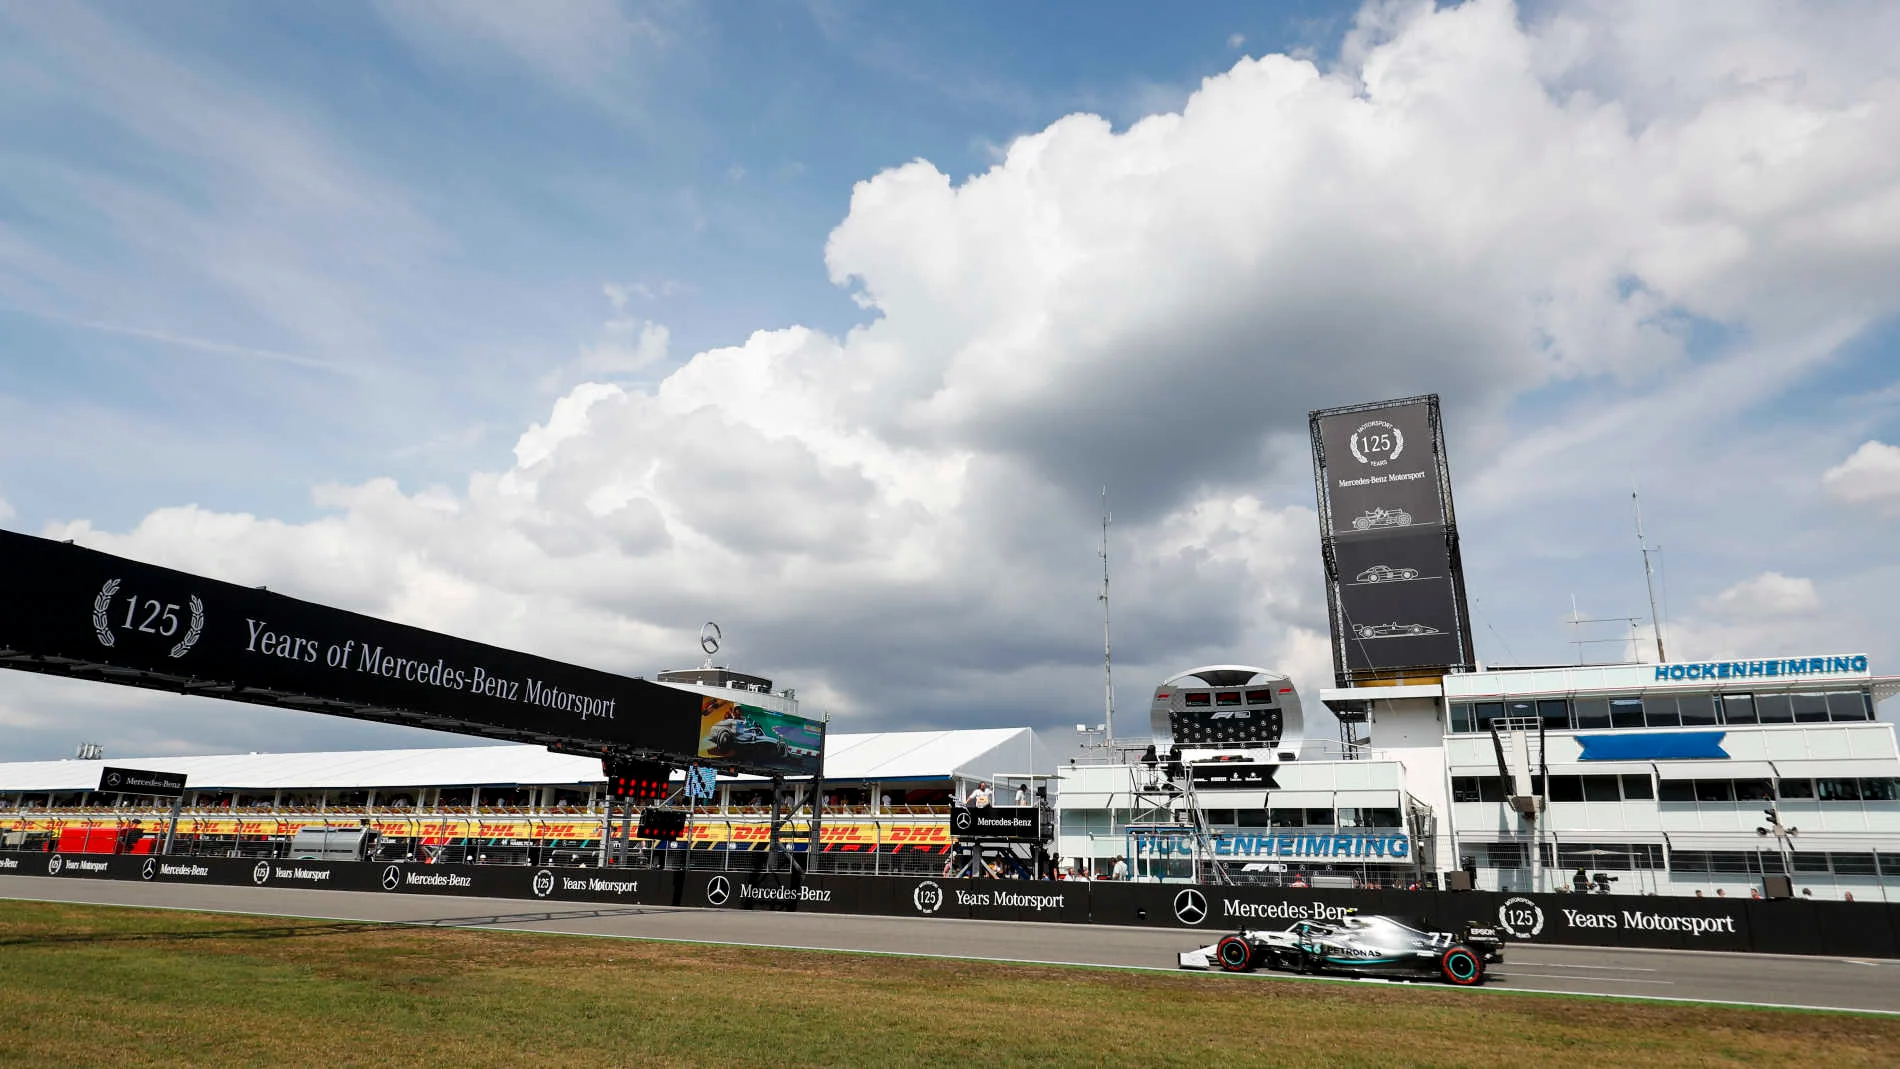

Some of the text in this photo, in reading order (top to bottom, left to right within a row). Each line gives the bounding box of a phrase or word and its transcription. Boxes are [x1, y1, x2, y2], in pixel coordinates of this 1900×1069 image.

[1357, 420, 1394, 433] MOTORSPORT
[1361, 433, 1391, 453] 125
[1370, 459, 1388, 467] YEARS
[1338, 471, 1425, 488] Mercedes-Benz Motorsport
[121, 594, 181, 637] 125
[246, 618, 617, 721] Years of Mercedes-Benz Motorsport
[1655, 655, 1868, 681] HOCKENHEIMRING
[126, 777, 181, 789] Mercedes-Benz
[977, 817, 1032, 827] Mercedes-Benz
[733, 826, 771, 840] DH
[890, 827, 947, 841] DHL
[65, 859, 109, 873] Years Motorsport
[160, 863, 209, 876] Mercedes-Benz
[256, 867, 266, 877] 125
[275, 867, 330, 881] Years Motorsport
[405, 871, 472, 887] Mercedes-Benz
[537, 877, 549, 889] 125
[562, 876, 638, 894] Years Motorsport
[739, 883, 832, 902] Mercedes-Benz
[919, 890, 936, 904] 125
[955, 890, 1065, 911] Years Motorsport
[1223, 898, 1348, 920] Mercedes-Ben
[1508, 909, 1534, 926] 125
[1562, 908, 1736, 936] Years Motorsport
[1470, 927, 1496, 936] EPSON
[1428, 931, 1454, 948] 77
[1327, 944, 1382, 957] PETRONAS
